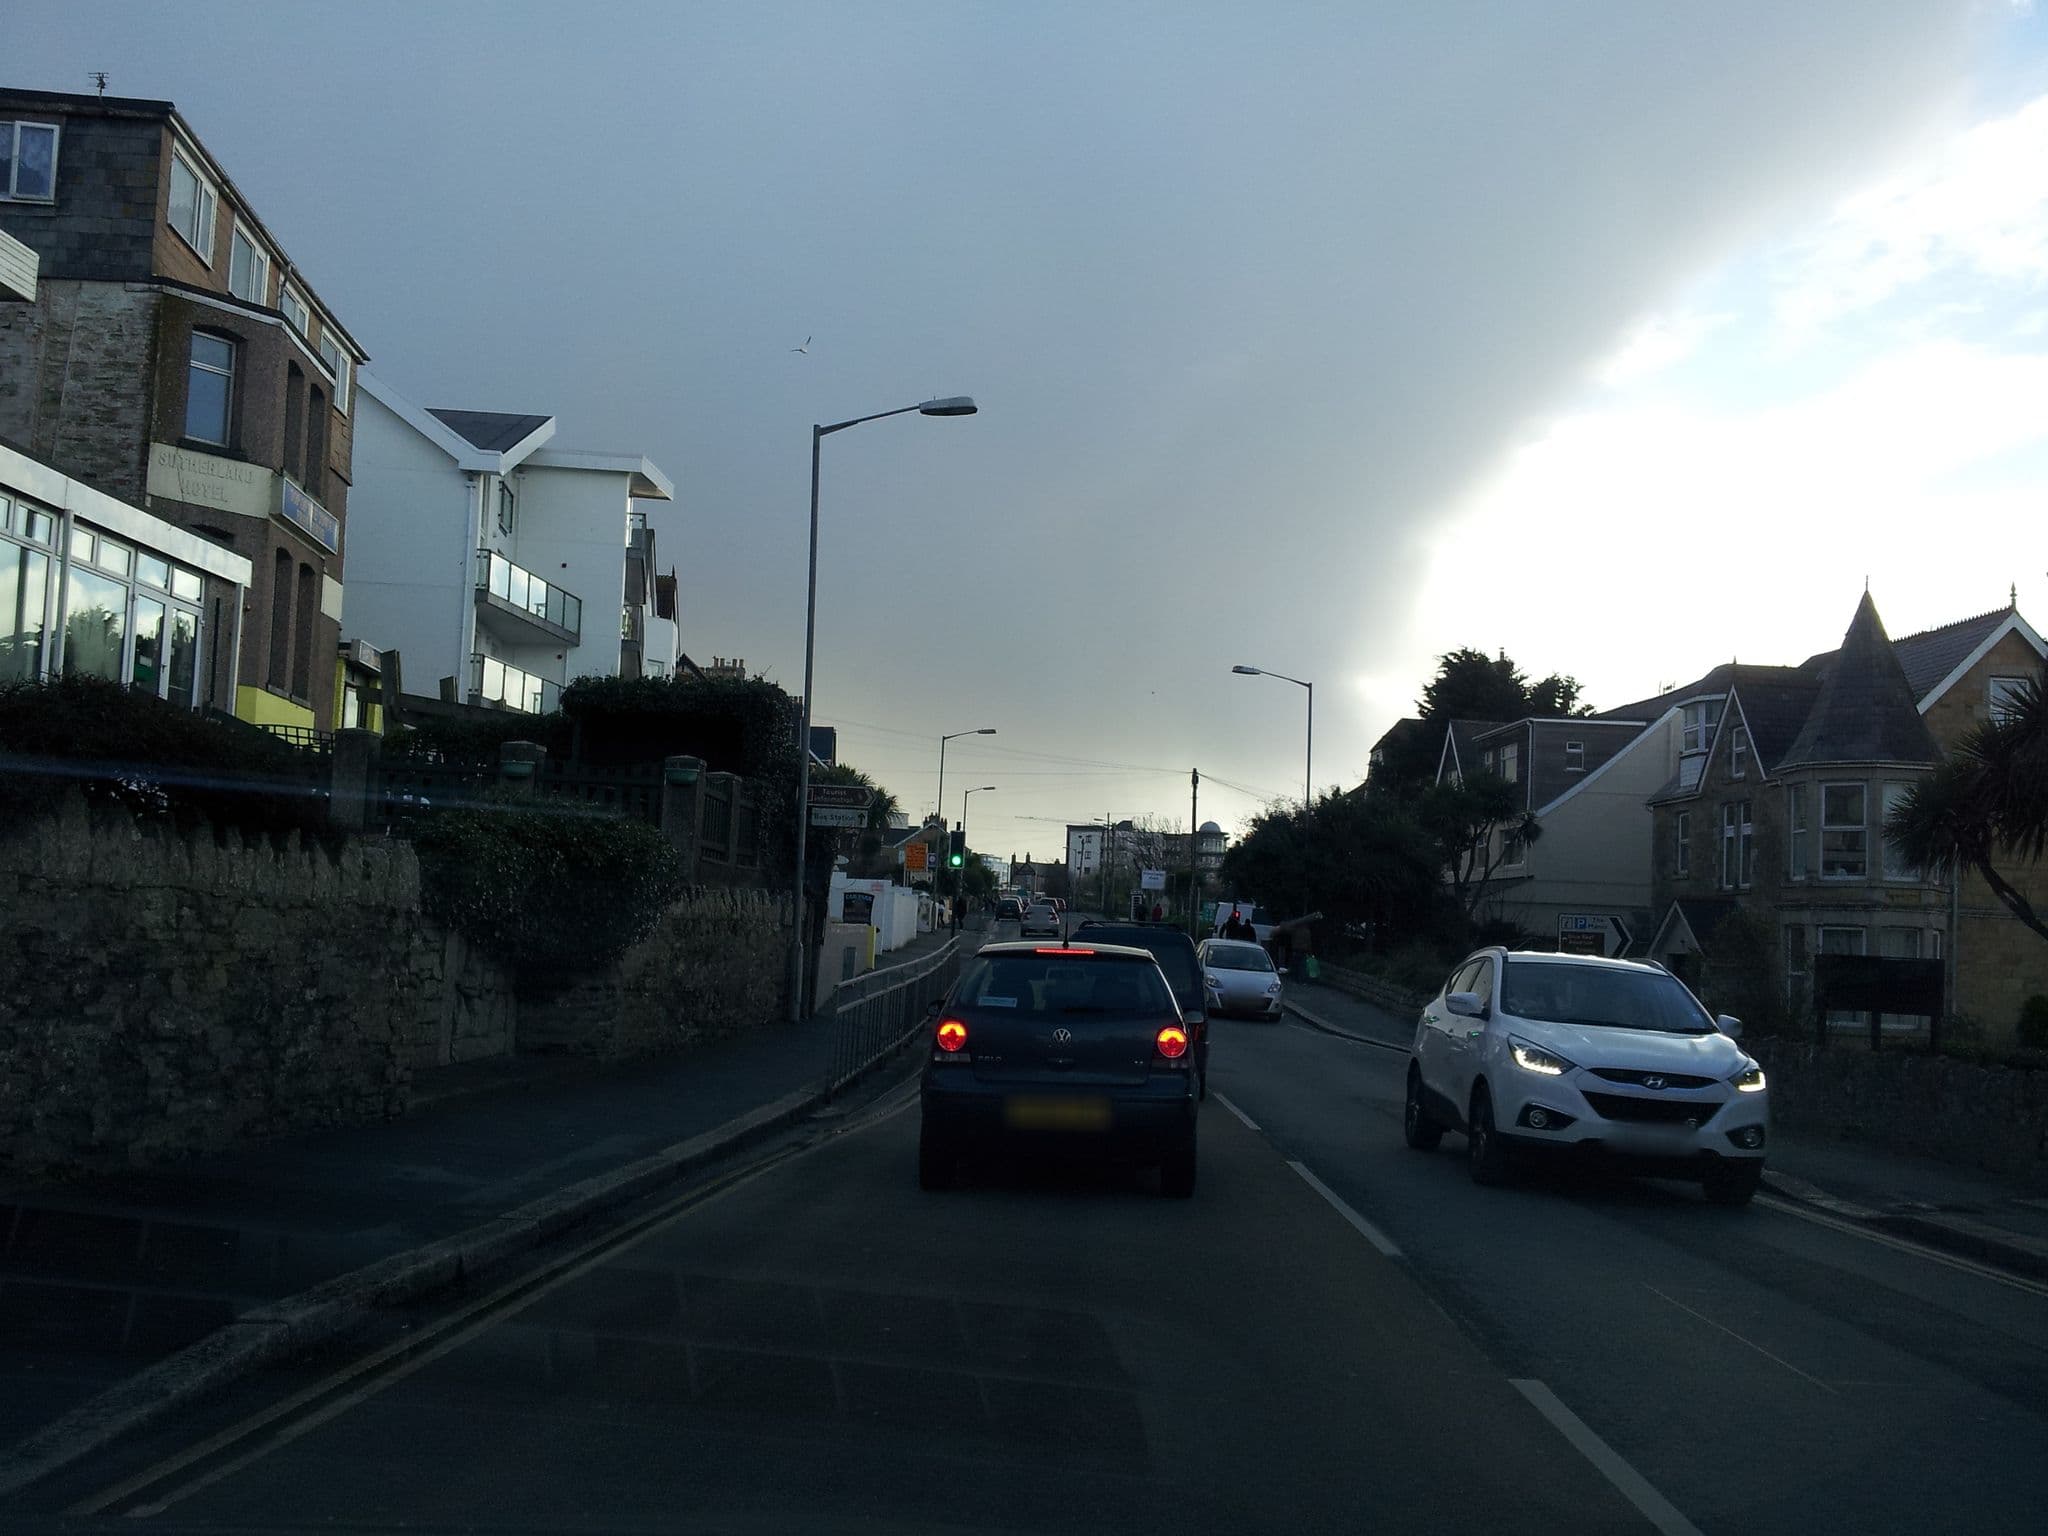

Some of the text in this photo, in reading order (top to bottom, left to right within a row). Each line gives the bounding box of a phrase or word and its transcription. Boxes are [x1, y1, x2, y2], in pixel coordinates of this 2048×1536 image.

[158, 451, 257, 485] SUTHERLAND
[181, 478, 229, 503] HOTEL
[822, 787, 848, 796] Tourist
[830, 811, 857, 822] Station
